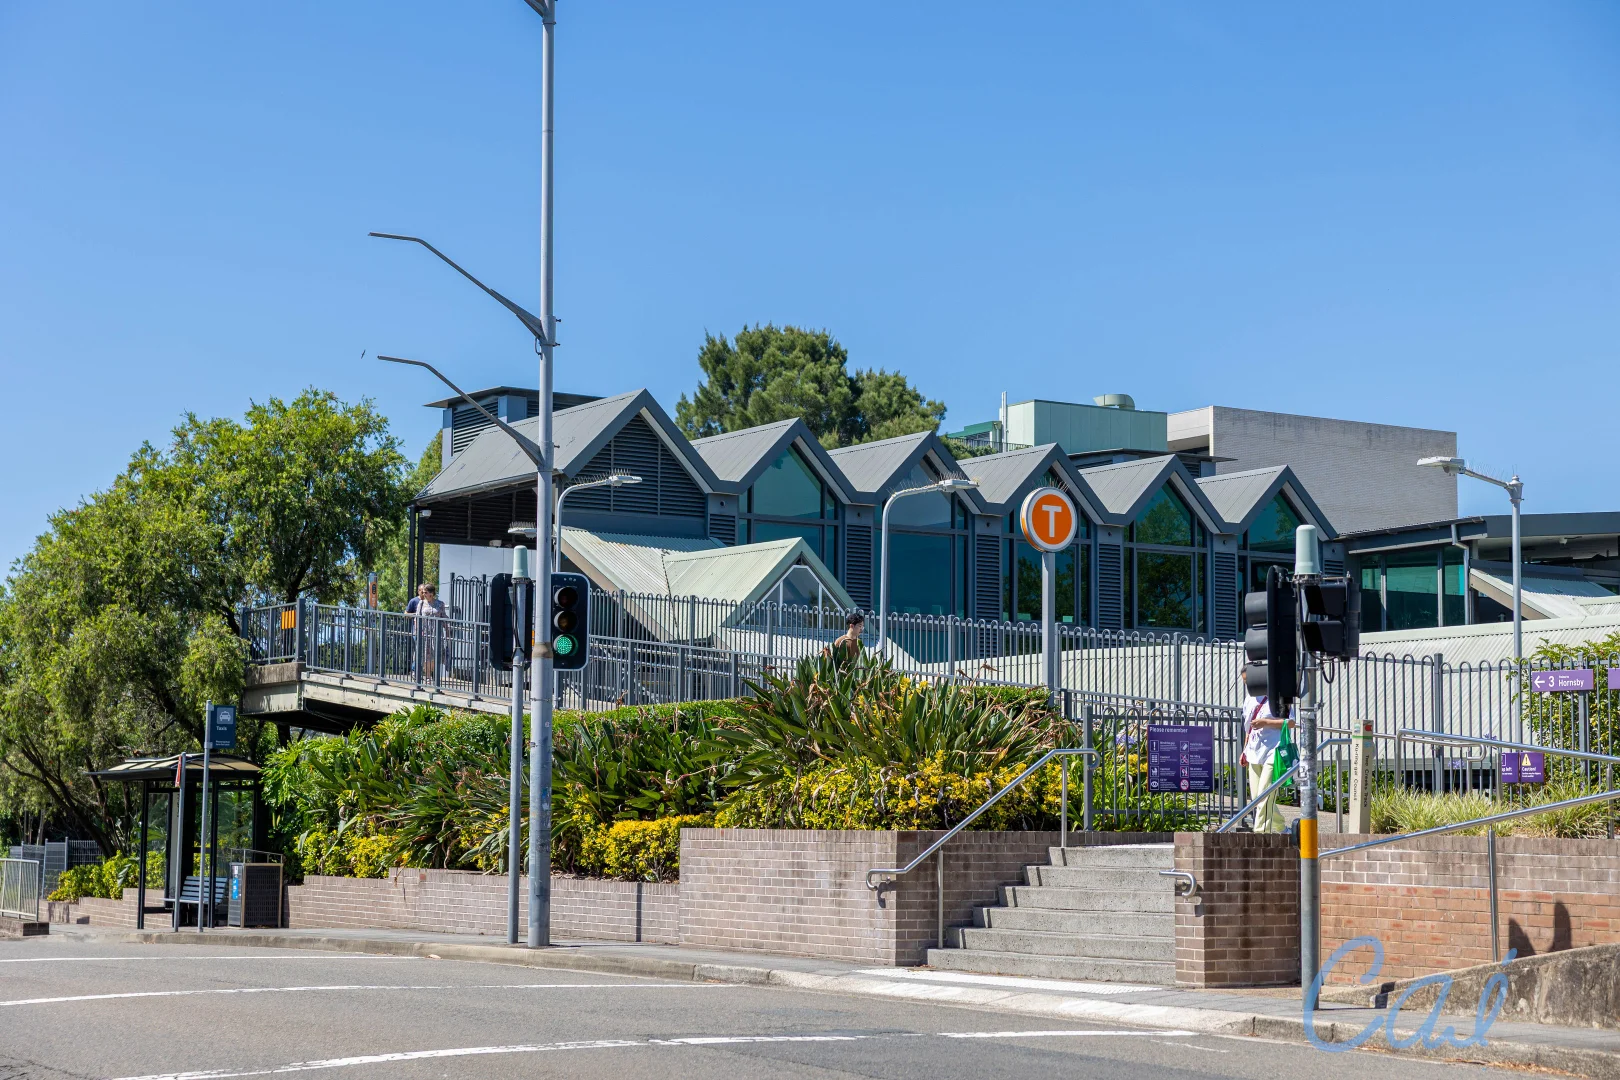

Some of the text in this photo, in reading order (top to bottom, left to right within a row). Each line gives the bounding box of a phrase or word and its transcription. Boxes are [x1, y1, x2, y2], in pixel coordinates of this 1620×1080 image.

[1041, 504, 1062, 538] T
[1548, 675, 1584, 687] 3 Hornsby
